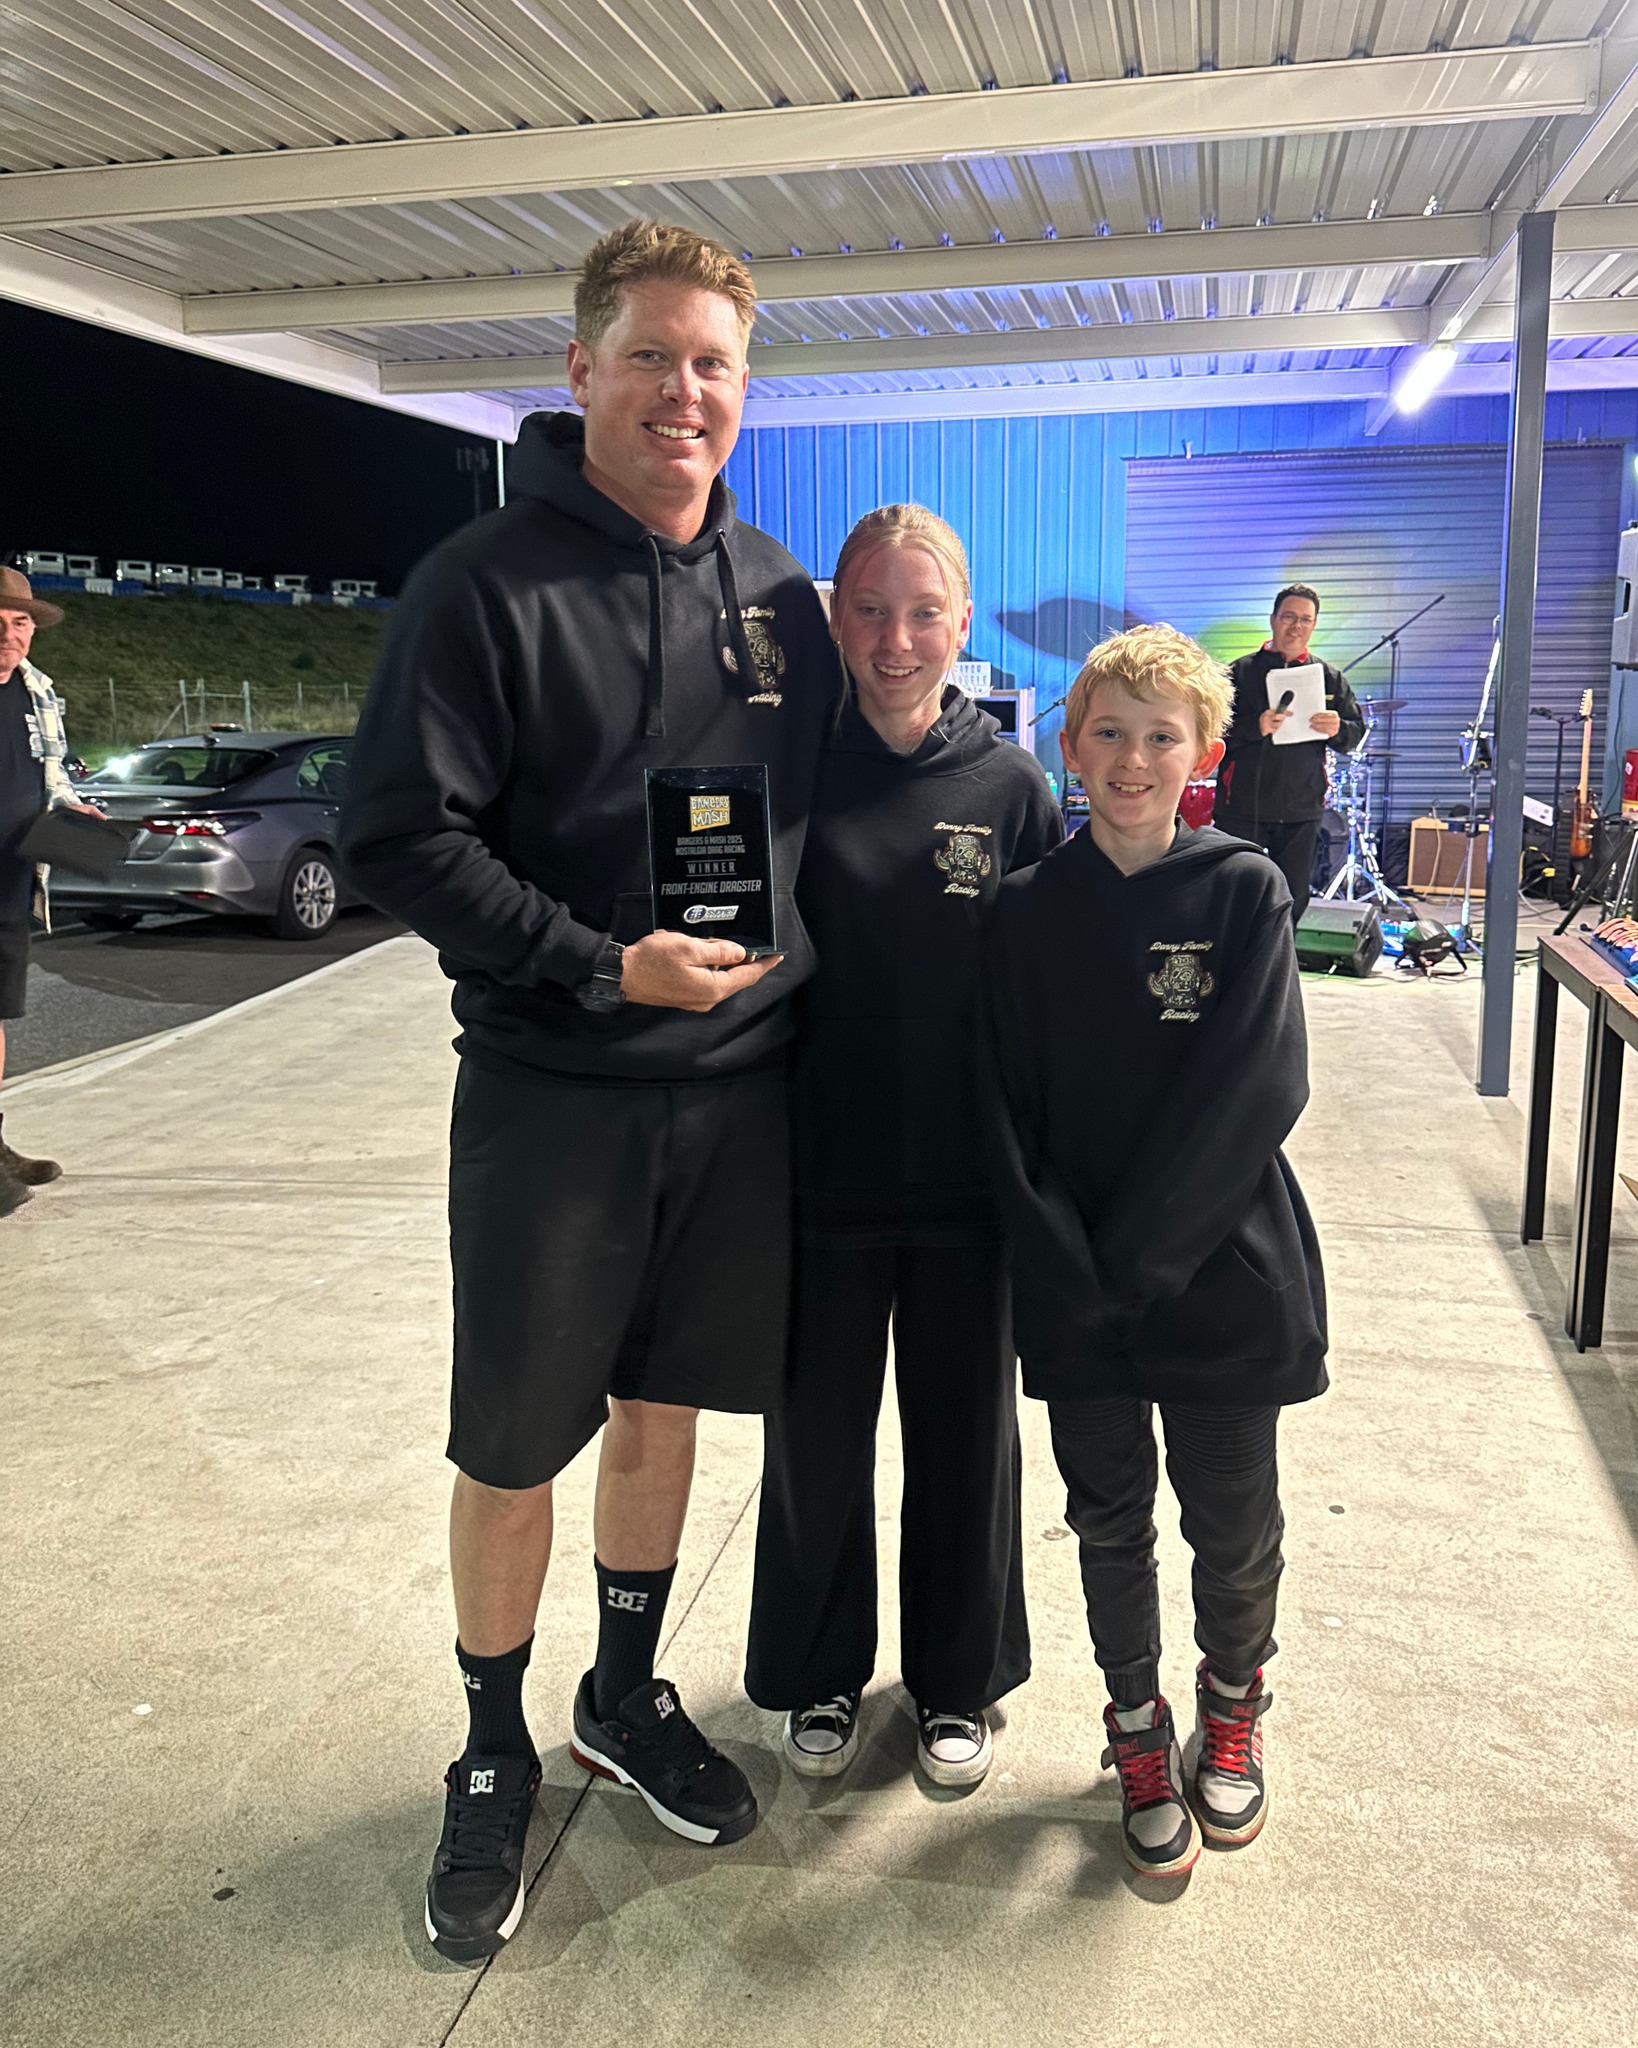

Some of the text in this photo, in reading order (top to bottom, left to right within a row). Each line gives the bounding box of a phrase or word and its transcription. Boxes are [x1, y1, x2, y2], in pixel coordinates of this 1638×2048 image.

[692, 811, 728, 826] MASH
[676, 836, 703, 846] BANGERS
[709, 835, 727, 845] MASH
[727, 834, 743, 844] 2025
[675, 844, 746, 856] NOSTALGIA DRAG RACING
[687, 861, 735, 874] WINNER
[661, 880, 762, 895] FRONT-ENGINE DRAGSTER
[944, 882, 980, 898] Racing
[1160, 1008, 1200, 1022] Racing
